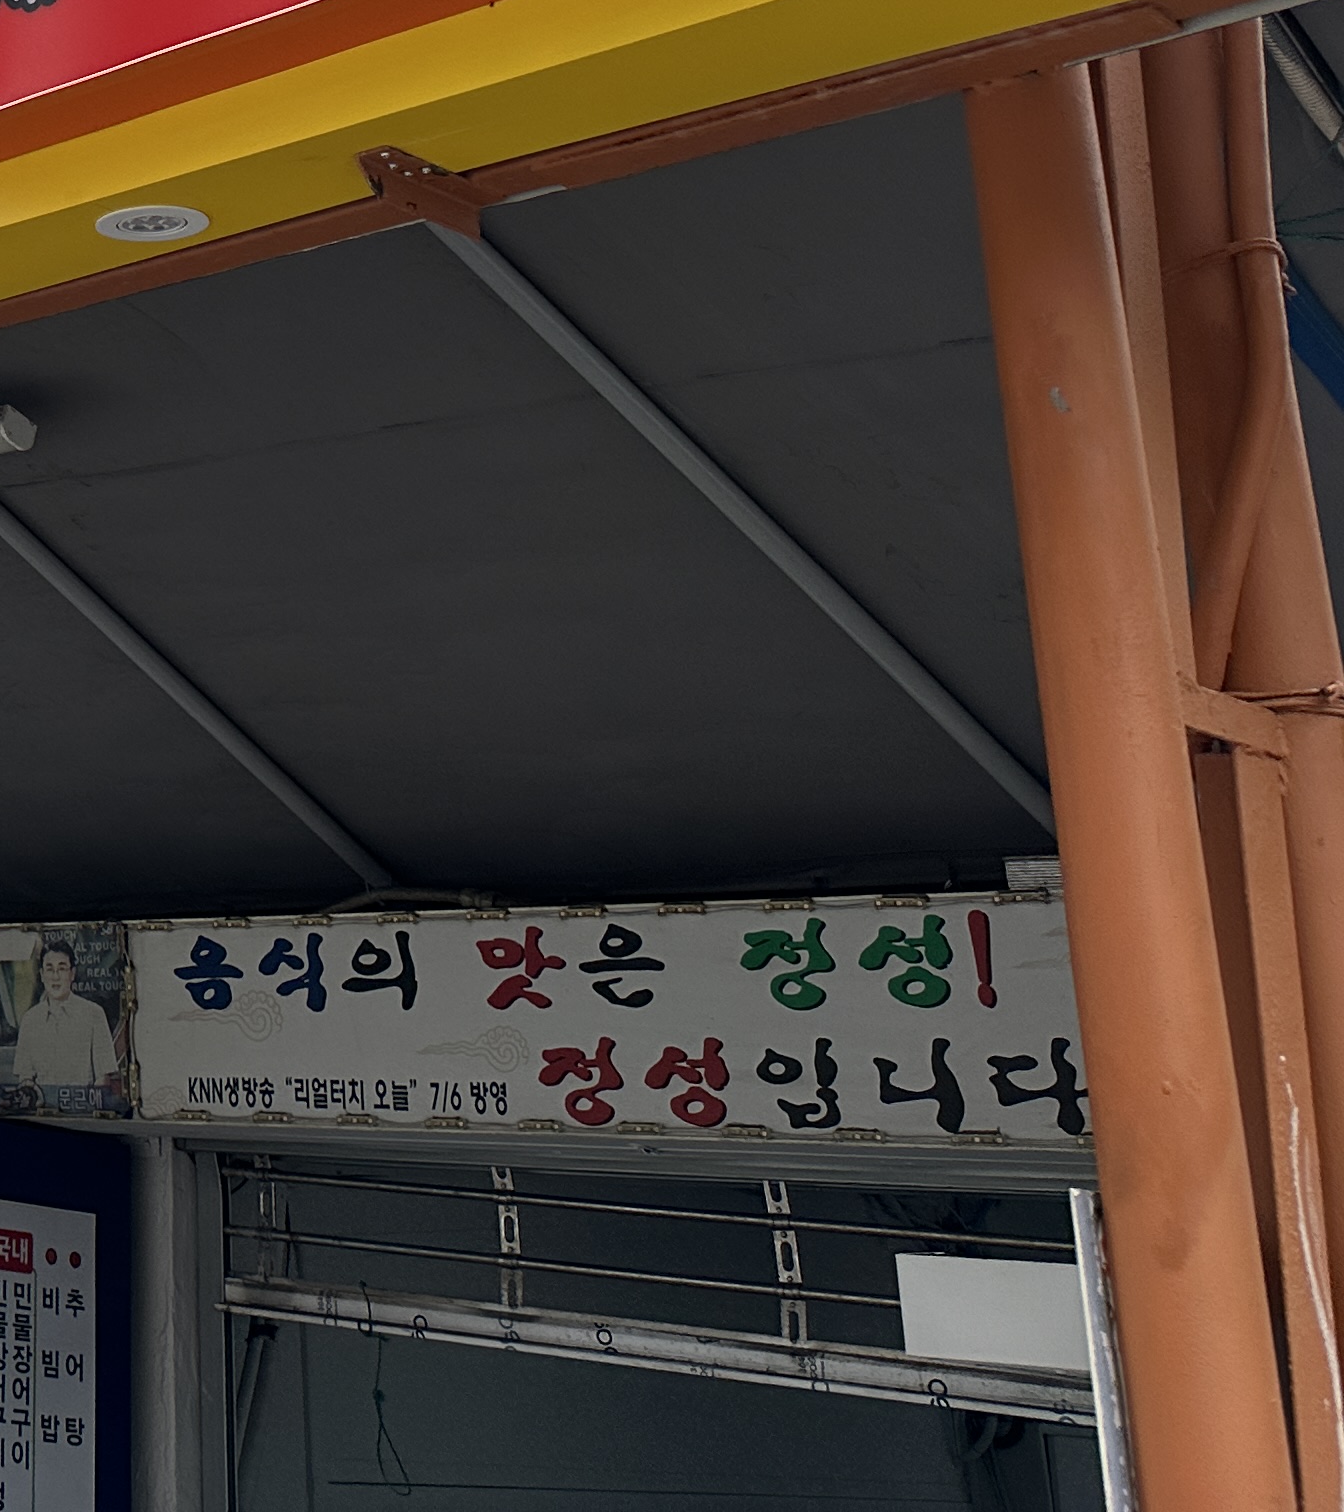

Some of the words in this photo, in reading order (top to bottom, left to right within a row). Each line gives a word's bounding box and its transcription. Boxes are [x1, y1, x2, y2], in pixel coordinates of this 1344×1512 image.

[44, 931, 77, 939] TOUCH
[173, 928, 420, 1013] 음식의
[474, 922, 666, 1011] 맛은
[739, 908, 999, 1011] 정성!
[59, 1089, 103, 1110] 문근애
[187, 1076, 275, 1109] KNN생방송
[429, 1081, 463, 1113] 7/6
[468, 1080, 509, 1116] 방영
[537, 1034, 1090, 1136] 정성입니다
[10, 1281, 33, 1471] 민물장어구이
[40, 1286, 61, 1445] 비빔밥
[64, 1289, 86, 1448] 추어탕
